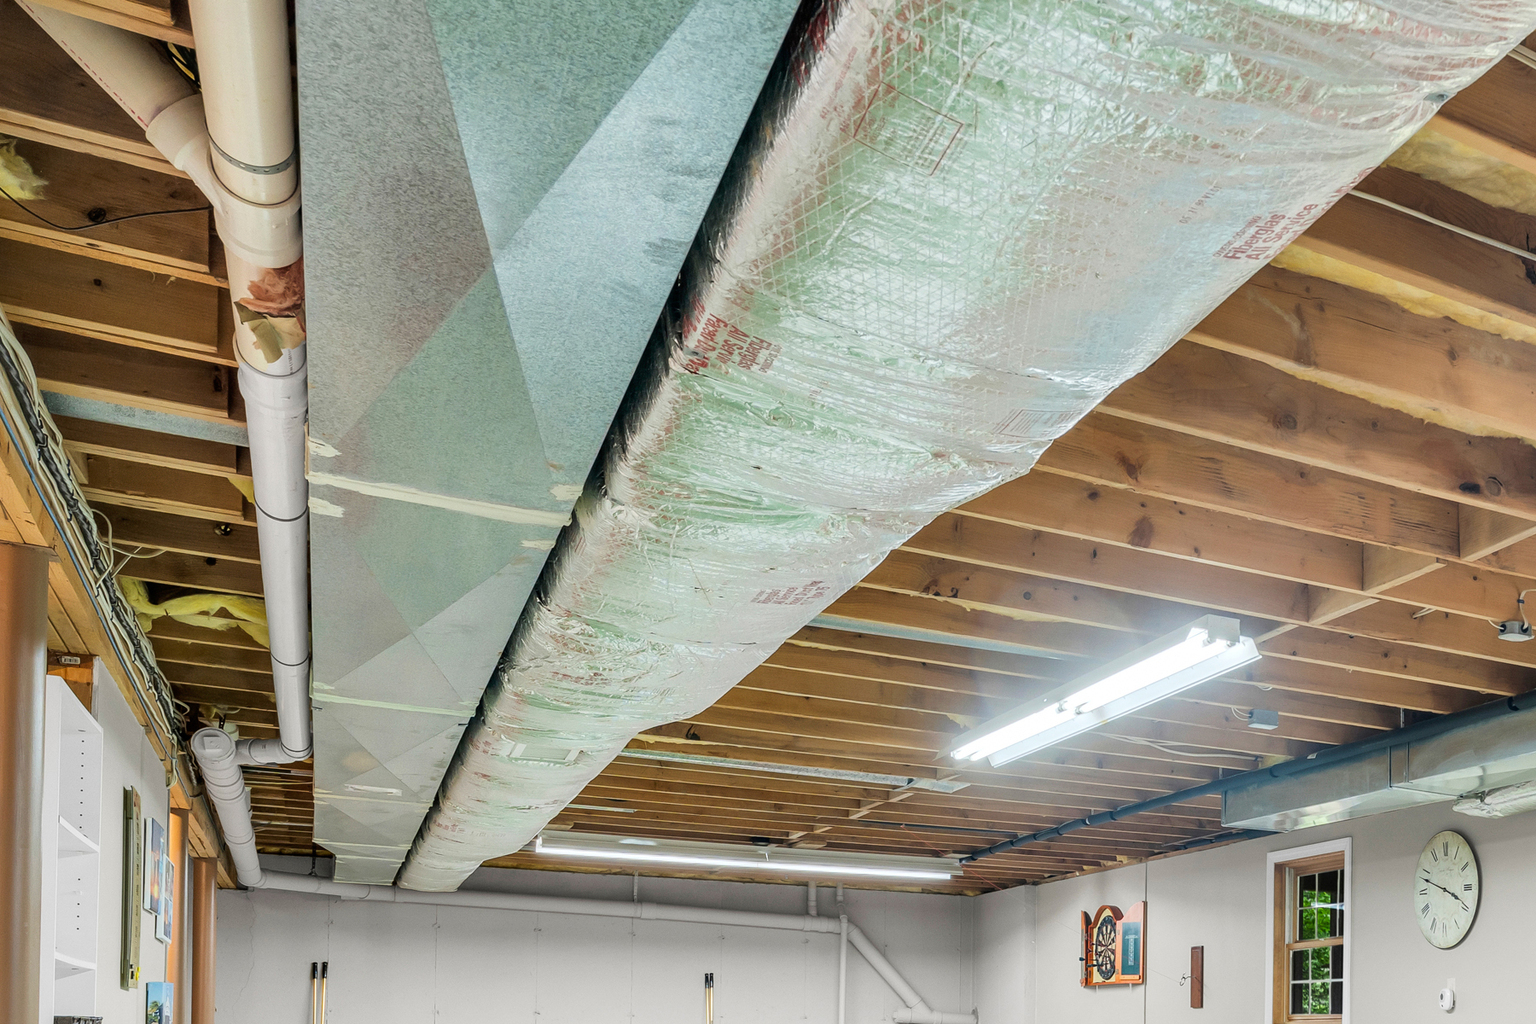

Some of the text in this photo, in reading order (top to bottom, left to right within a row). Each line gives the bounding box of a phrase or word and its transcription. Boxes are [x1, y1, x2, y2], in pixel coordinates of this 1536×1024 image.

[1223, 213, 1286, 260] Fiberglas
[1245, 203, 1319, 260] All Service
[700, 313, 728, 345] Faced
